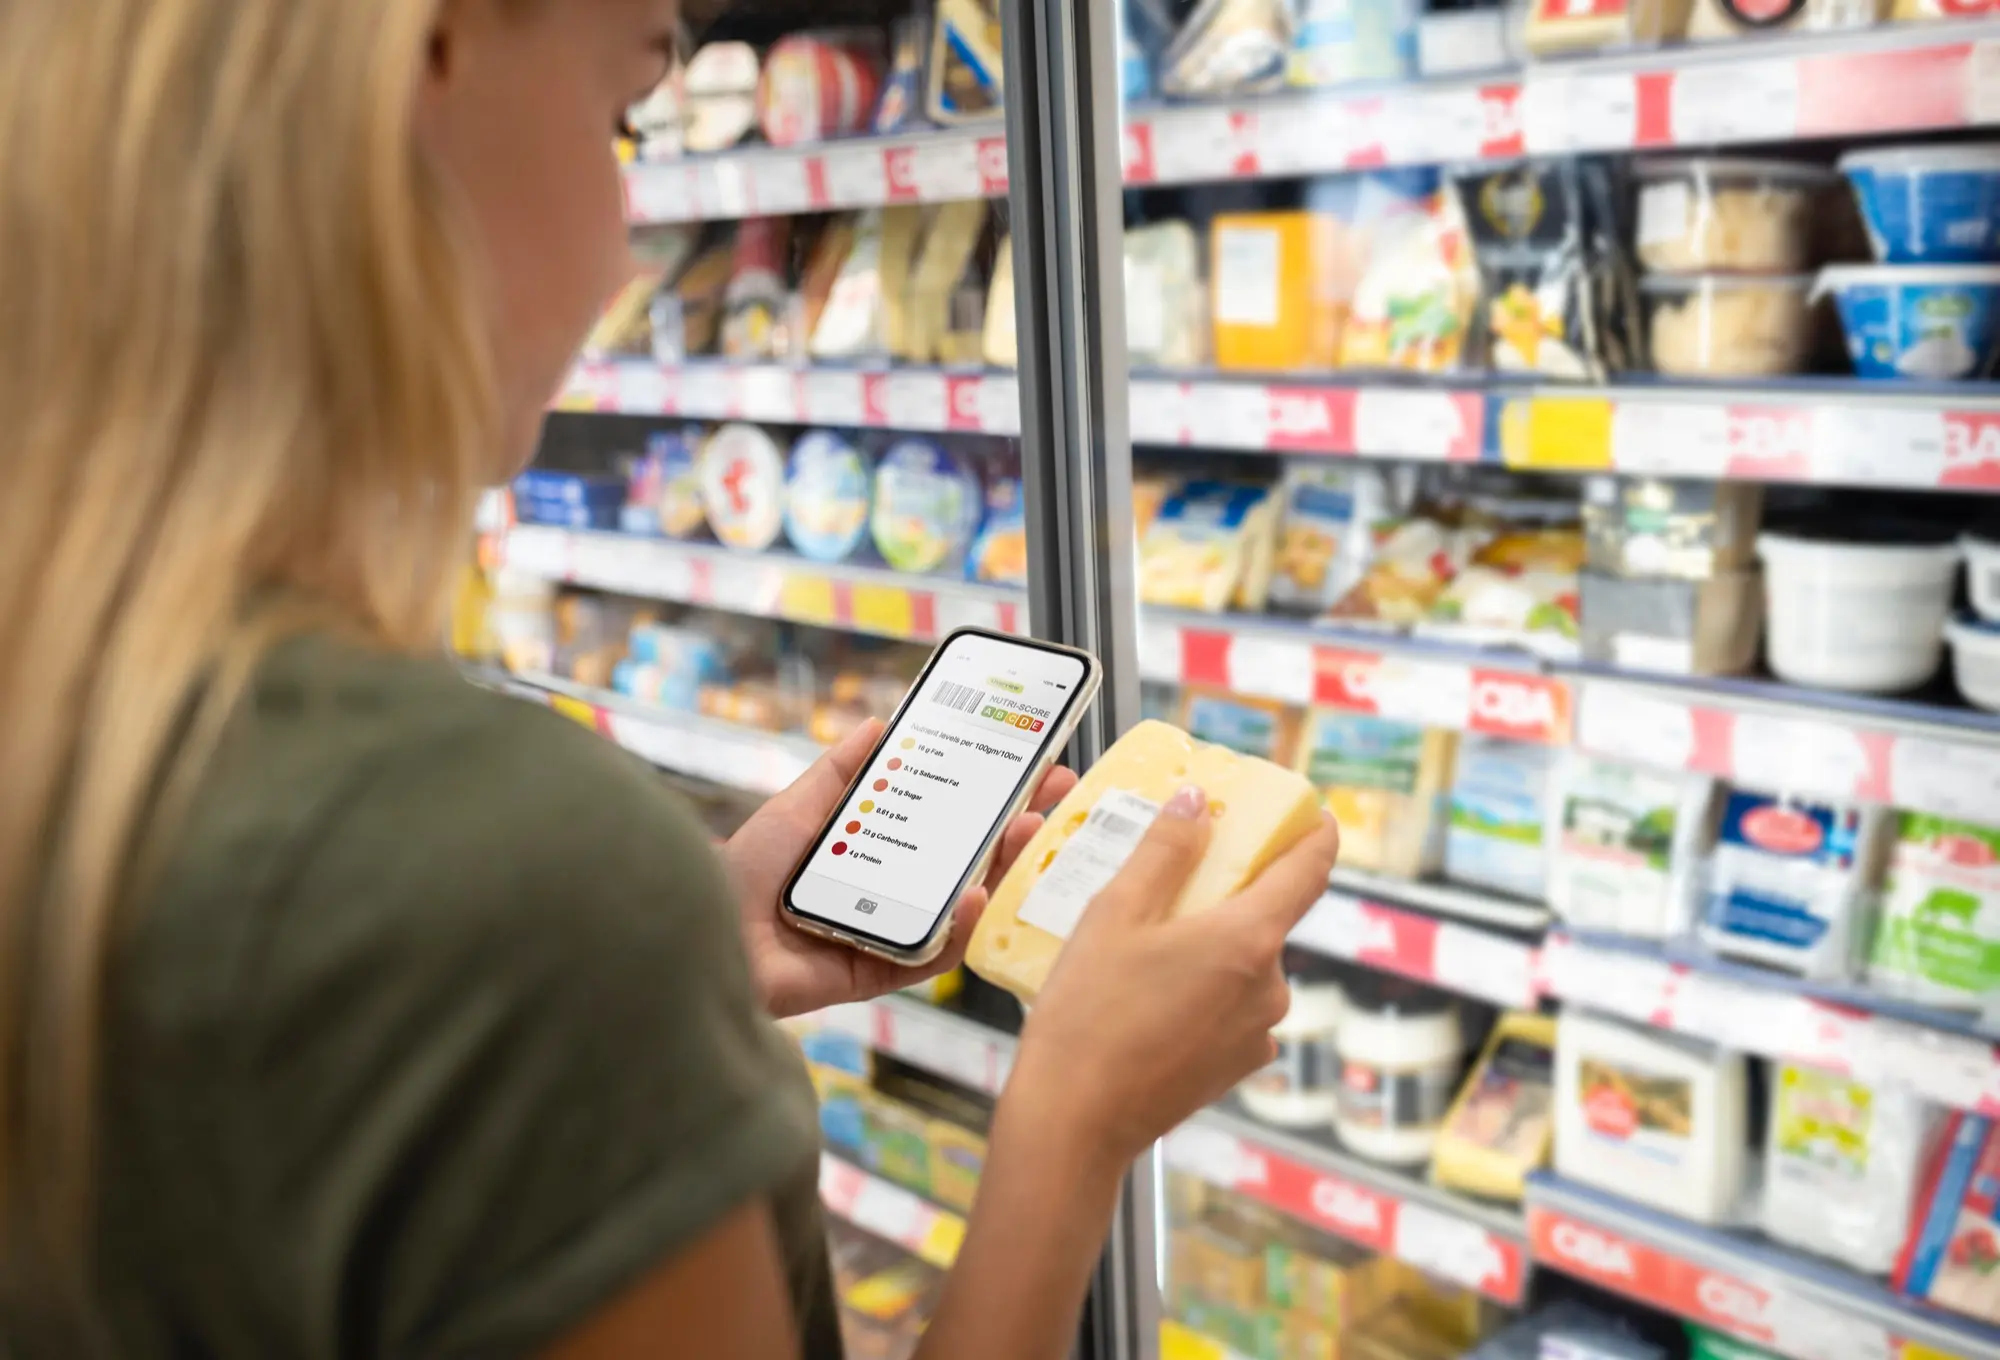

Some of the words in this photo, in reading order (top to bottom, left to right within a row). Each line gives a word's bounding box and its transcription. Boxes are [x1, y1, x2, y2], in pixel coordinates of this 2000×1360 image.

[990, 678, 1020, 691] Overview
[990, 694, 1051, 719] NUTRI-SCORE
[1471, 682, 1558, 728] CBA
[911, 722, 939, 738] Nutrient
[939, 730, 960, 744] levels
[960, 739, 973, 748] per
[975, 742, 1023, 763] 100gm/100ml
[930, 749, 944, 758] Fats
[903, 765, 912, 773] 5.1
[918, 770, 948, 784] Saturated
[948, 779, 960, 788] Fat
[903, 790, 922, 801] Sugar
[895, 813, 908, 822] Salt
[862, 828, 871, 836] 23
[876, 832, 918, 852] Carbohydrate
[859, 852, 882, 865] Protein
[1551, 1221, 1637, 1280] CBA
